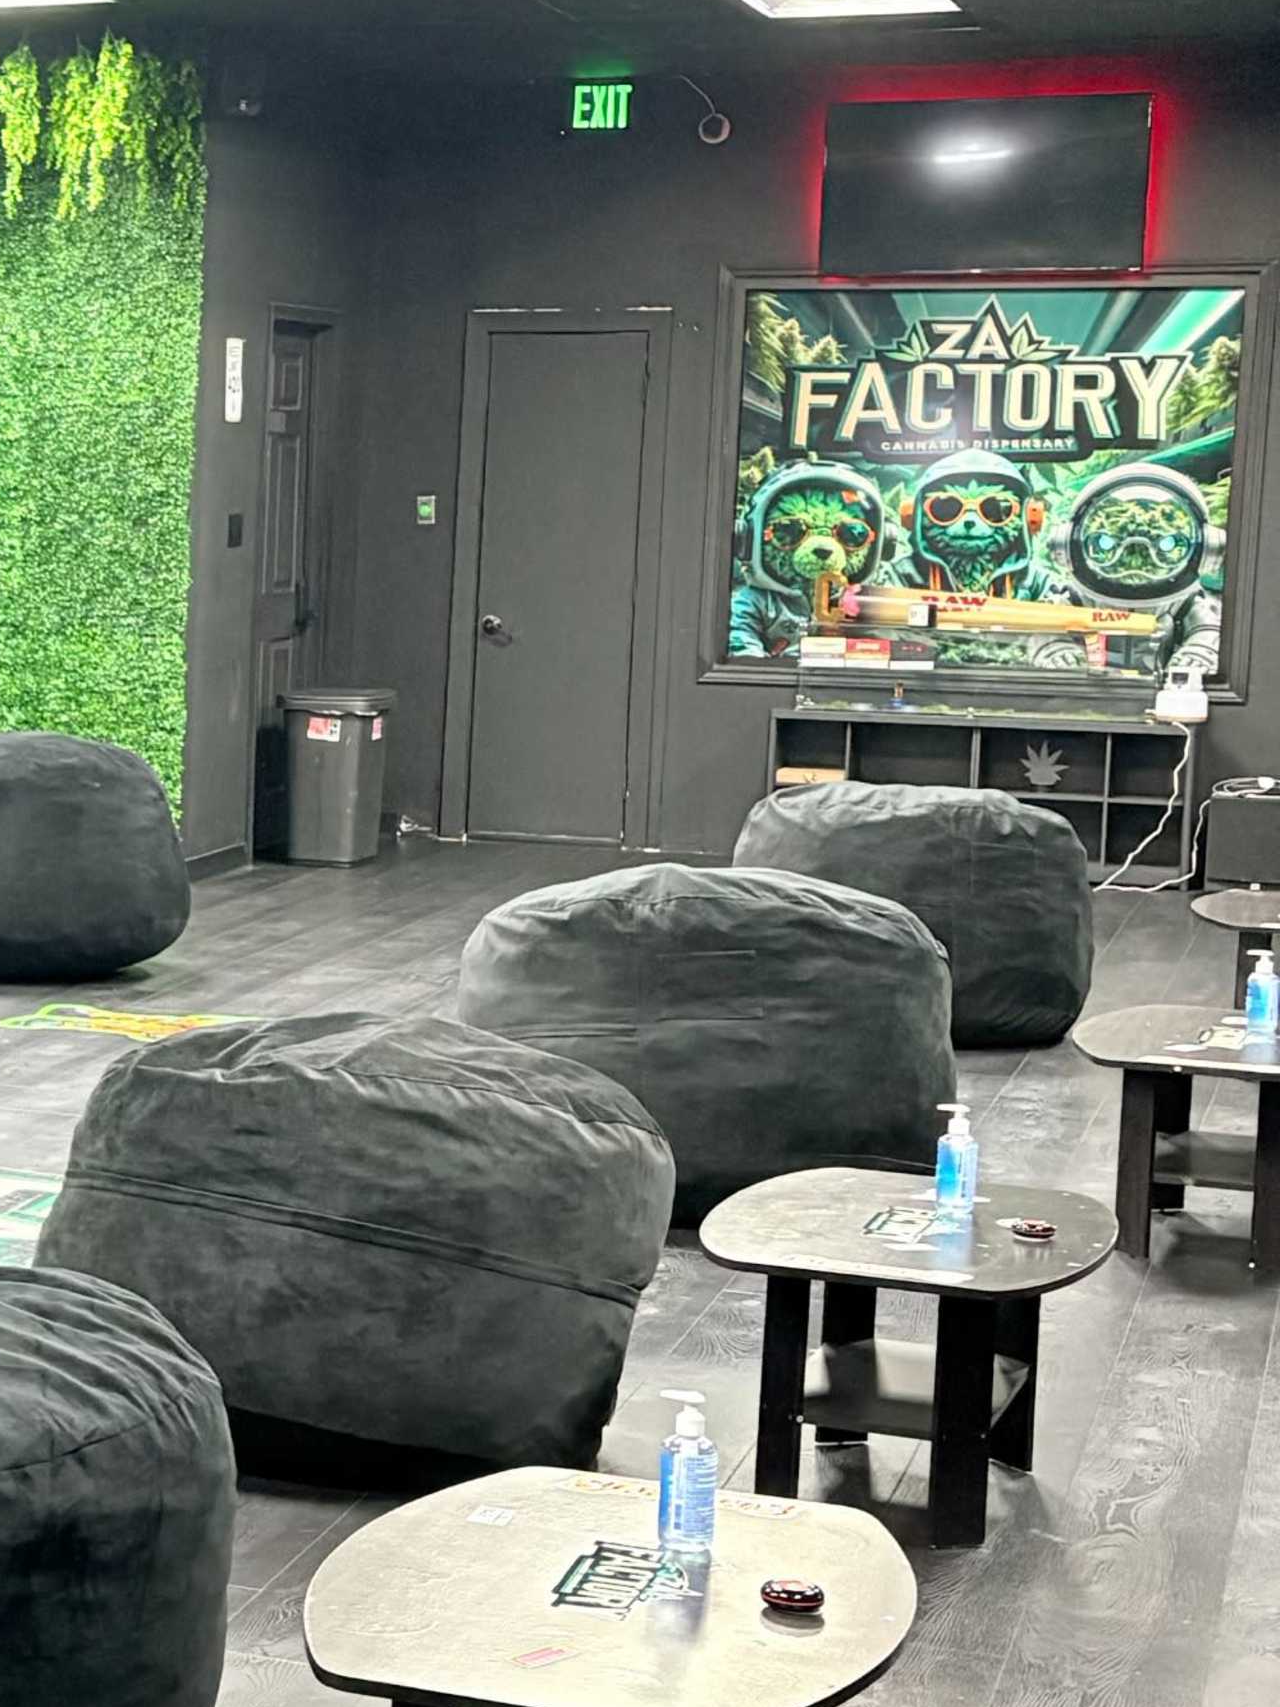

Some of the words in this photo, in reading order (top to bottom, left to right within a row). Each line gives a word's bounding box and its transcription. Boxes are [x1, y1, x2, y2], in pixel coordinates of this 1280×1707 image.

[572, 84, 633, 129] EXIT
[928, 312, 1011, 360] ZA
[789, 357, 1183, 448] FACTORY
[880, 439, 965, 452] CANNABIS
[971, 437, 1075, 451] DISPENSARY
[1092, 610, 1133, 624] RAW
